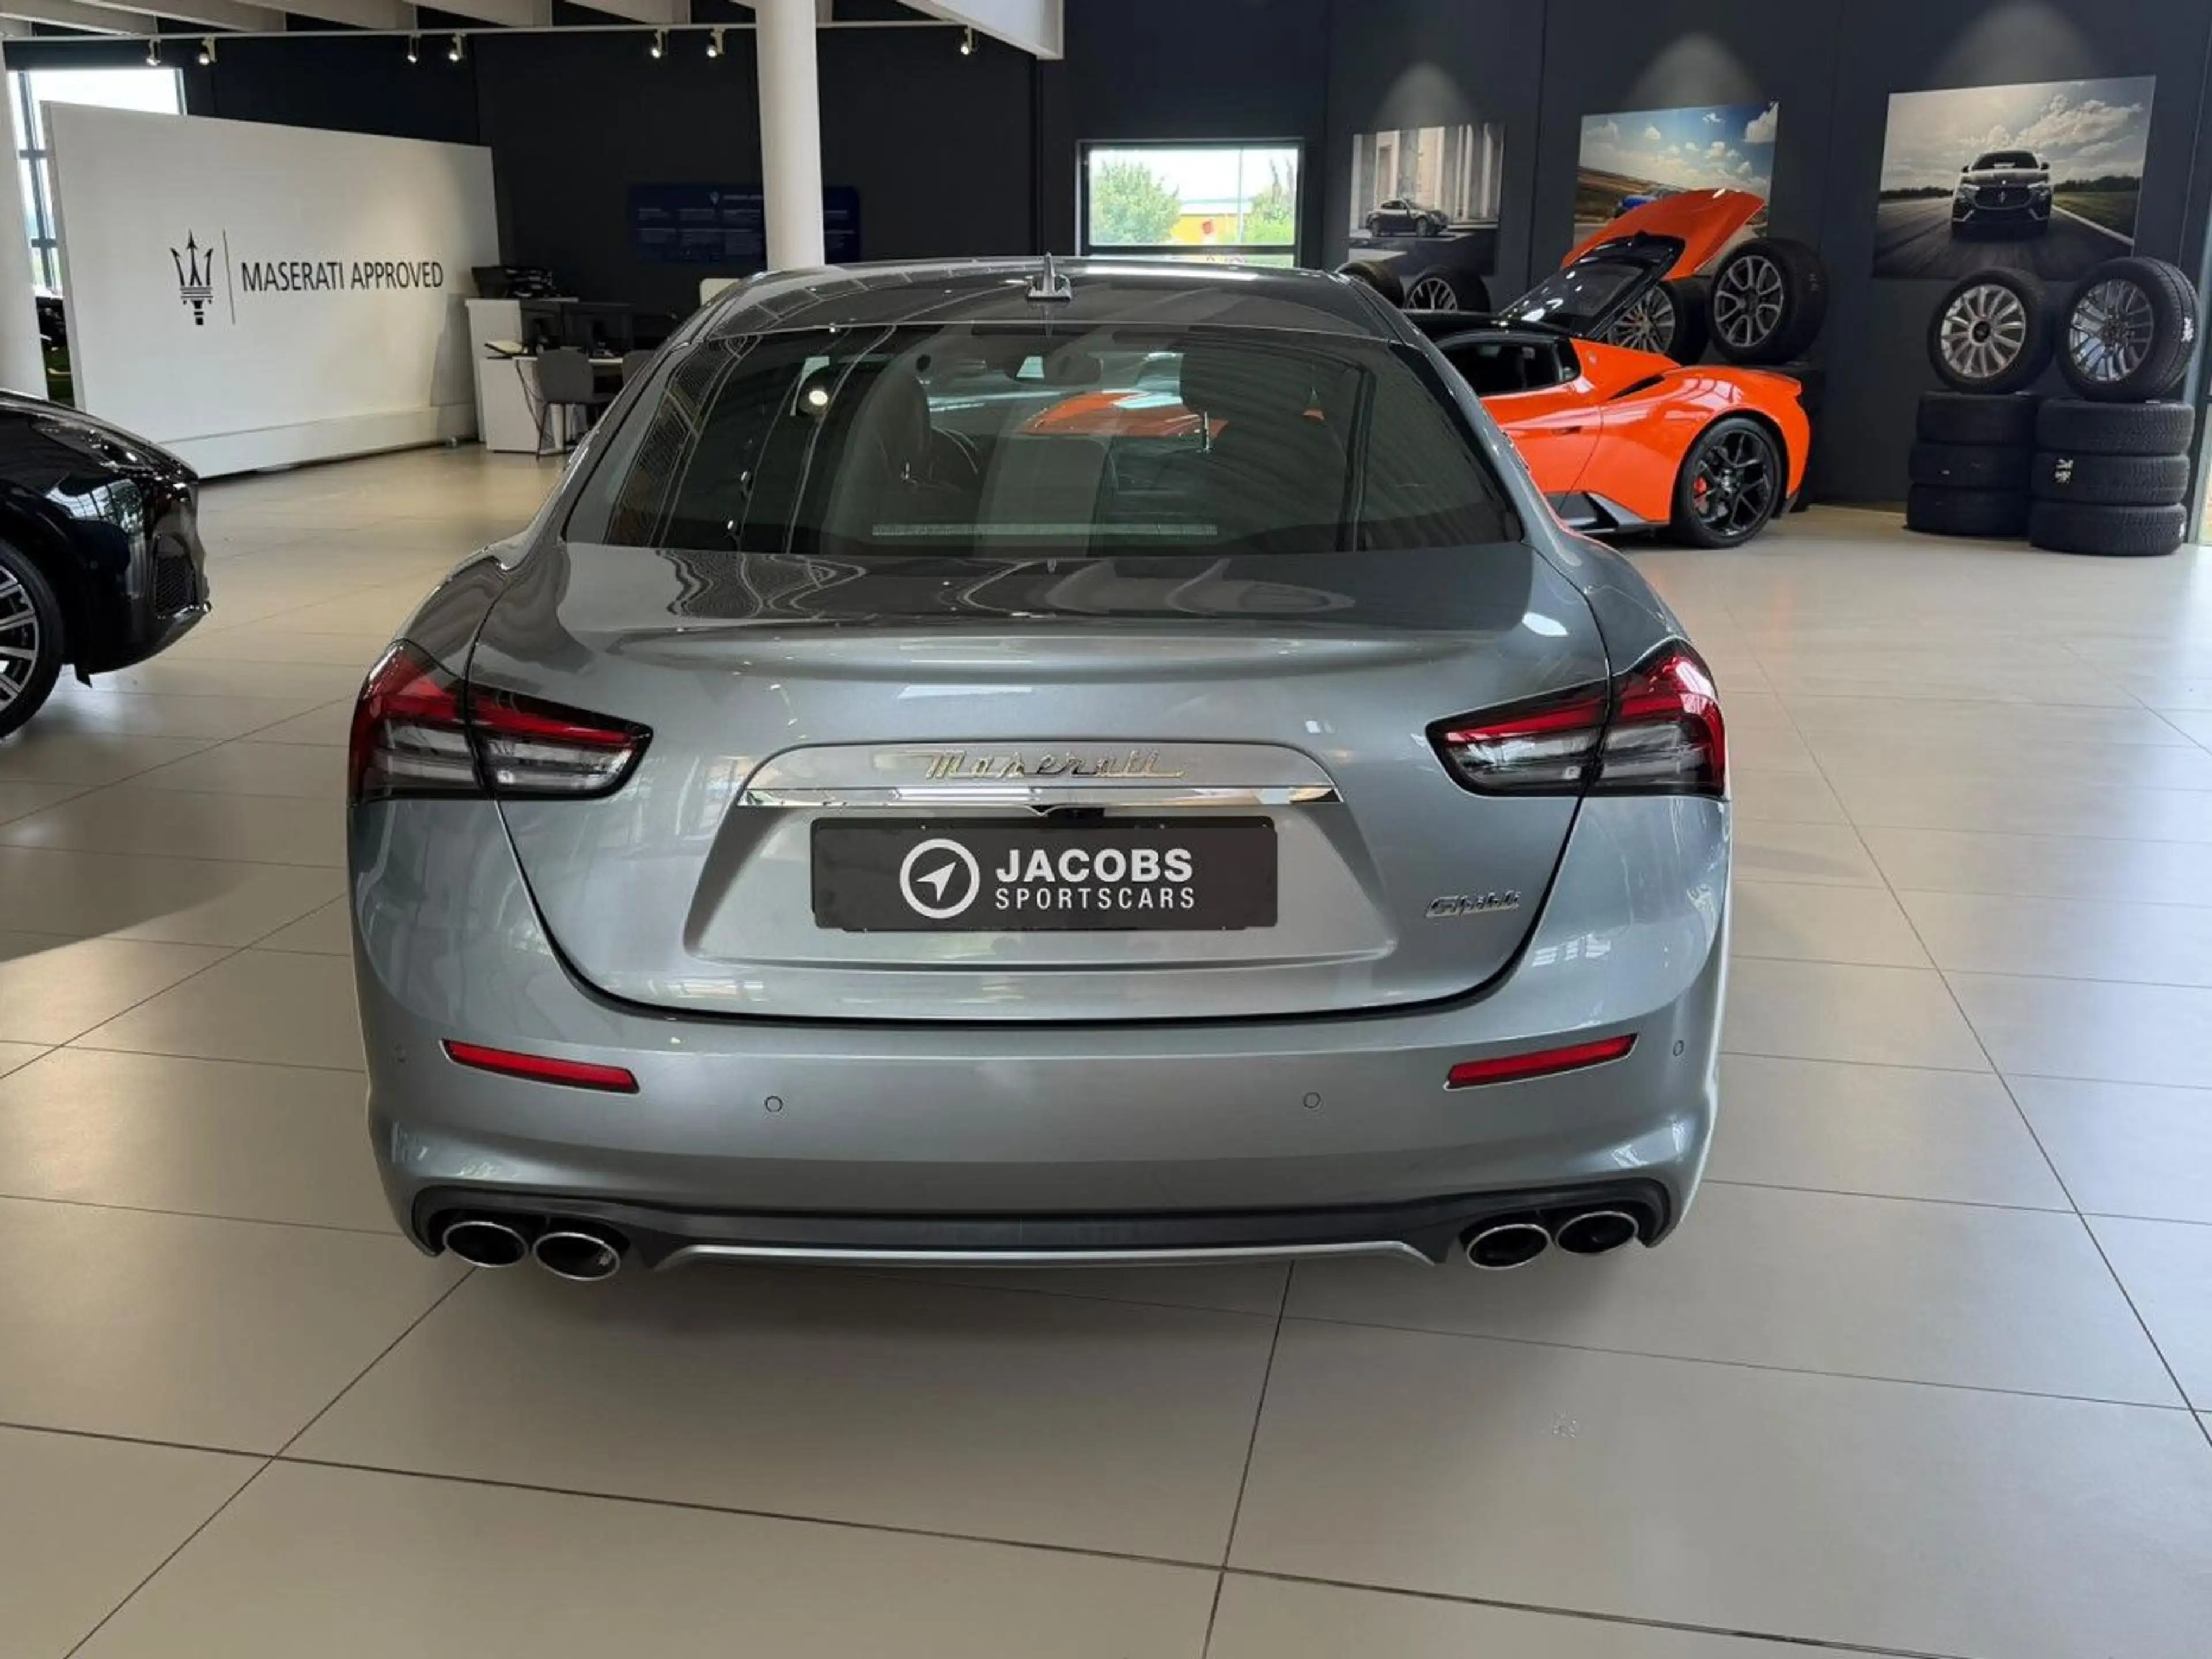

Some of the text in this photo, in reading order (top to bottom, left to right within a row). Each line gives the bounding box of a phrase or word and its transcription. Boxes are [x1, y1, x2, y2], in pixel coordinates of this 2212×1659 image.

[241, 260, 444, 291] MASERATI APPROVED
[921, 748, 1187, 780] Maserati
[995, 848, 1193, 883] JACOBS
[995, 887, 1195, 910] SPORTSCARS
